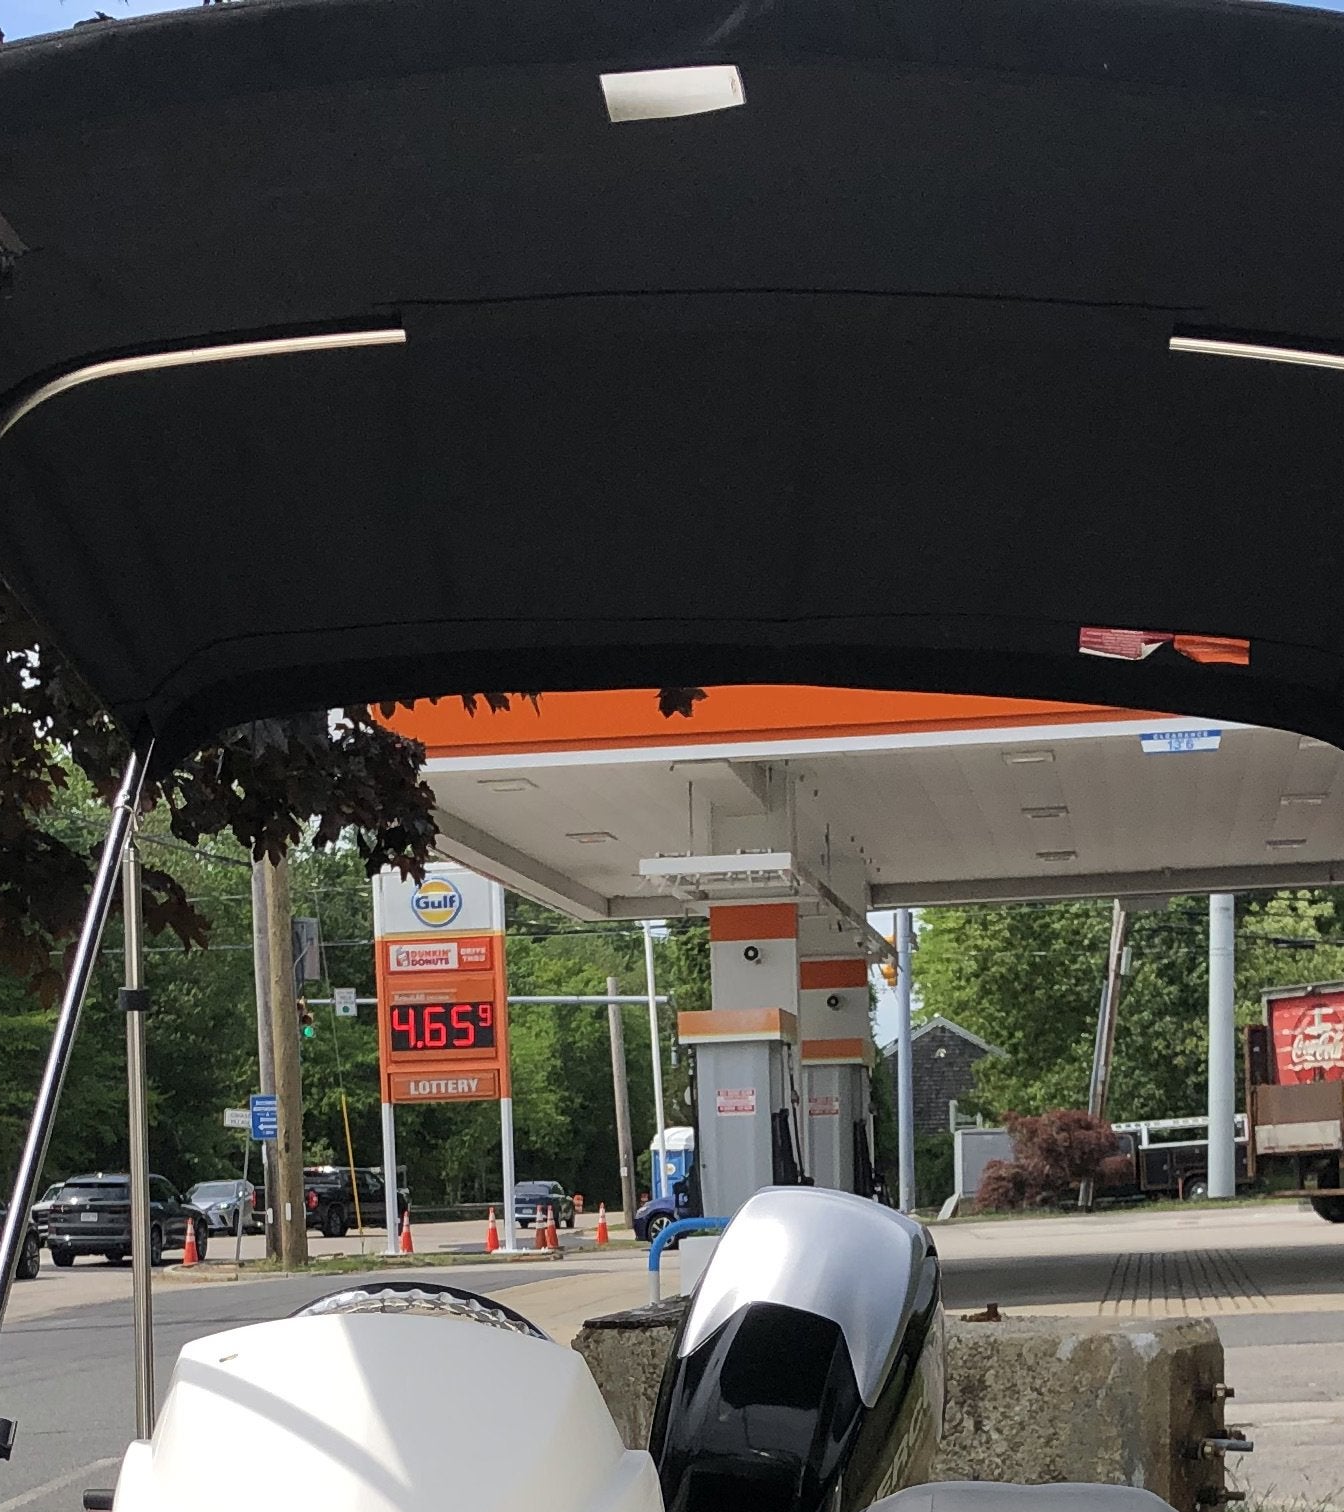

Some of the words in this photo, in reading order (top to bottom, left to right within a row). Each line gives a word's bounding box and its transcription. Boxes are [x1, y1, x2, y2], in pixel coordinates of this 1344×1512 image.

[415, 892, 456, 910] Gulf
[411, 957, 450, 967] DONUTS
[410, 1079, 479, 1095] LOTTERY
